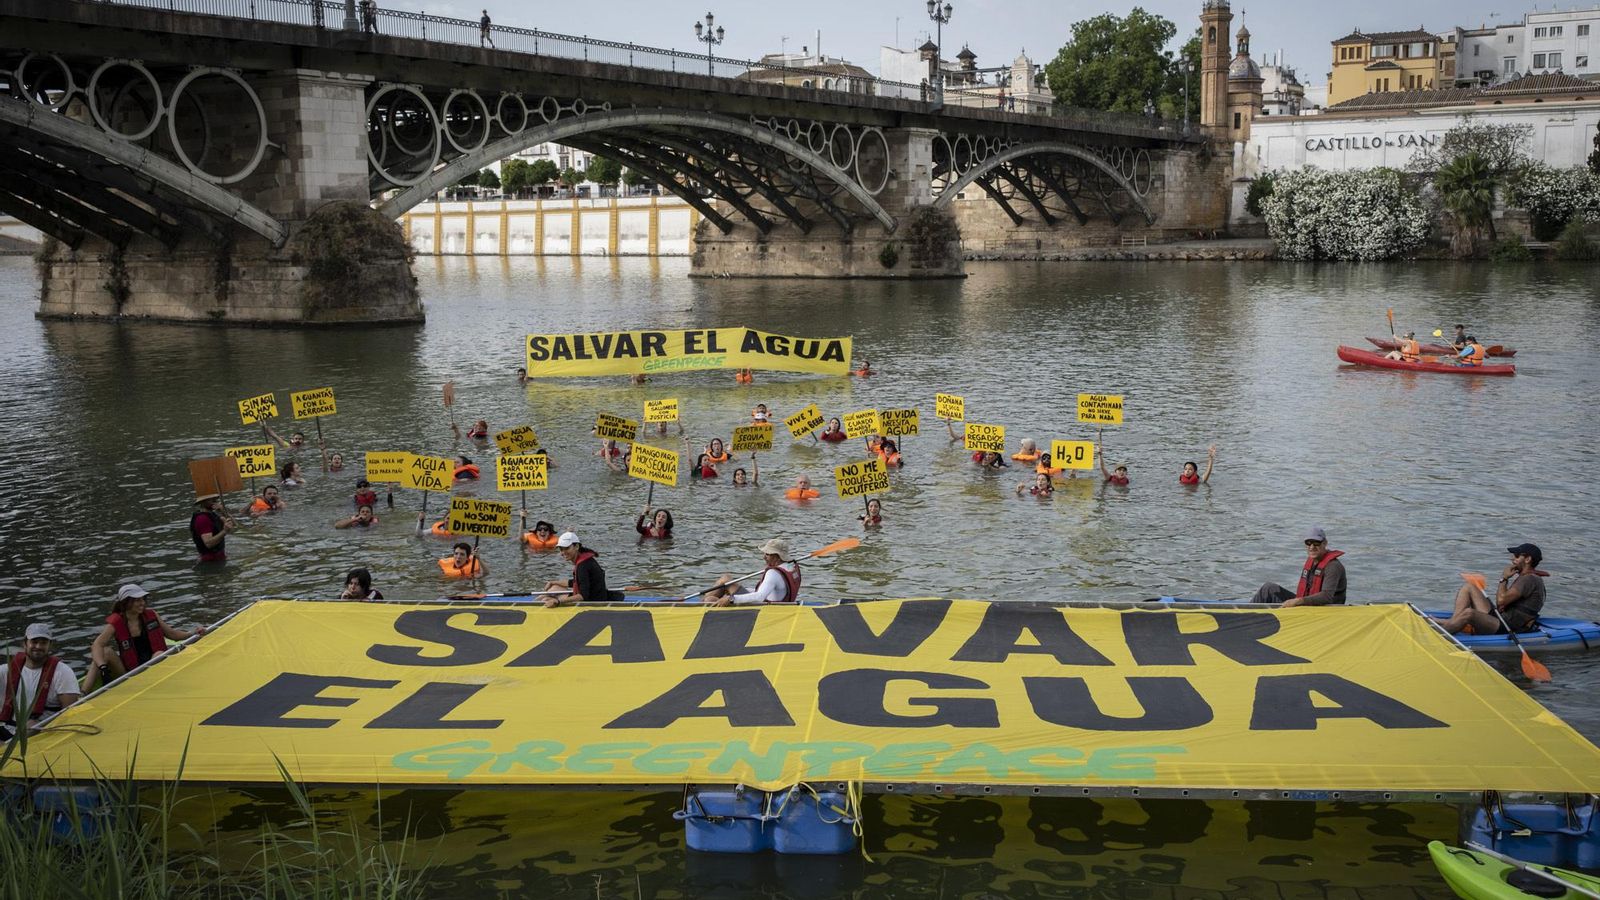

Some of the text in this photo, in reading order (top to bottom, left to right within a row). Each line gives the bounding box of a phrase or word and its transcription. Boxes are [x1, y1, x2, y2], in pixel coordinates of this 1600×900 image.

[1305, 136, 1382, 151] CASTILLO
[1398, 133, 1435, 148] SAN
[530, 330, 845, 362] SALVAR EL AGUA
[642, 356, 727, 371] GREENPEACE
[242, 399, 259, 411] SIN
[938, 395, 963, 406] DOÑANA
[1080, 401, 1122, 410] CONTAMINADA
[257, 403, 270, 413] HAY
[298, 404, 335, 416] DERROCHE
[938, 409, 963, 419] MAÑANA
[253, 411, 273, 422] VIDA
[787, 413, 806, 426] VIVE
[880, 411, 892, 419] TU
[848, 418, 873, 427] CUANDO
[496, 426, 533, 441] EL AGUA
[598, 426, 636, 440] TU NEGOCIO
[736, 426, 763, 434] CONTRA
[793, 426, 811, 437] DEJA
[886, 425, 918, 436] AGUA
[969, 425, 997, 433] STOP
[510, 434, 523, 443] NO
[228, 448, 273, 458] CAMPO GOLF
[501, 446, 513, 454] SE
[636, 445, 660, 457] MANGO
[240, 460, 272, 474] EQUÍA
[412, 458, 447, 471] AGUA
[501, 456, 545, 466] AGUACATE
[637, 455, 676, 473] HOY SEQUÍA
[504, 464, 520, 472] PARA
[632, 465, 673, 481] PARA MAÑANA
[841, 460, 878, 477] NO ME
[412, 474, 442, 488] VIDA
[502, 470, 543, 482] SEQUÍA
[838, 472, 888, 486] TOQUES LOS
[520, 479, 545, 487] MAÑANA
[453, 500, 512, 514] LOS VERTIDOS
[464, 511, 498, 522] NO SON
[453, 520, 507, 536] DIVERTIDOS
[366, 599, 1312, 667] SALVAR
[201, 668, 1450, 731] EL AGUA
[391, 740, 1189, 781] GREENPEACE
